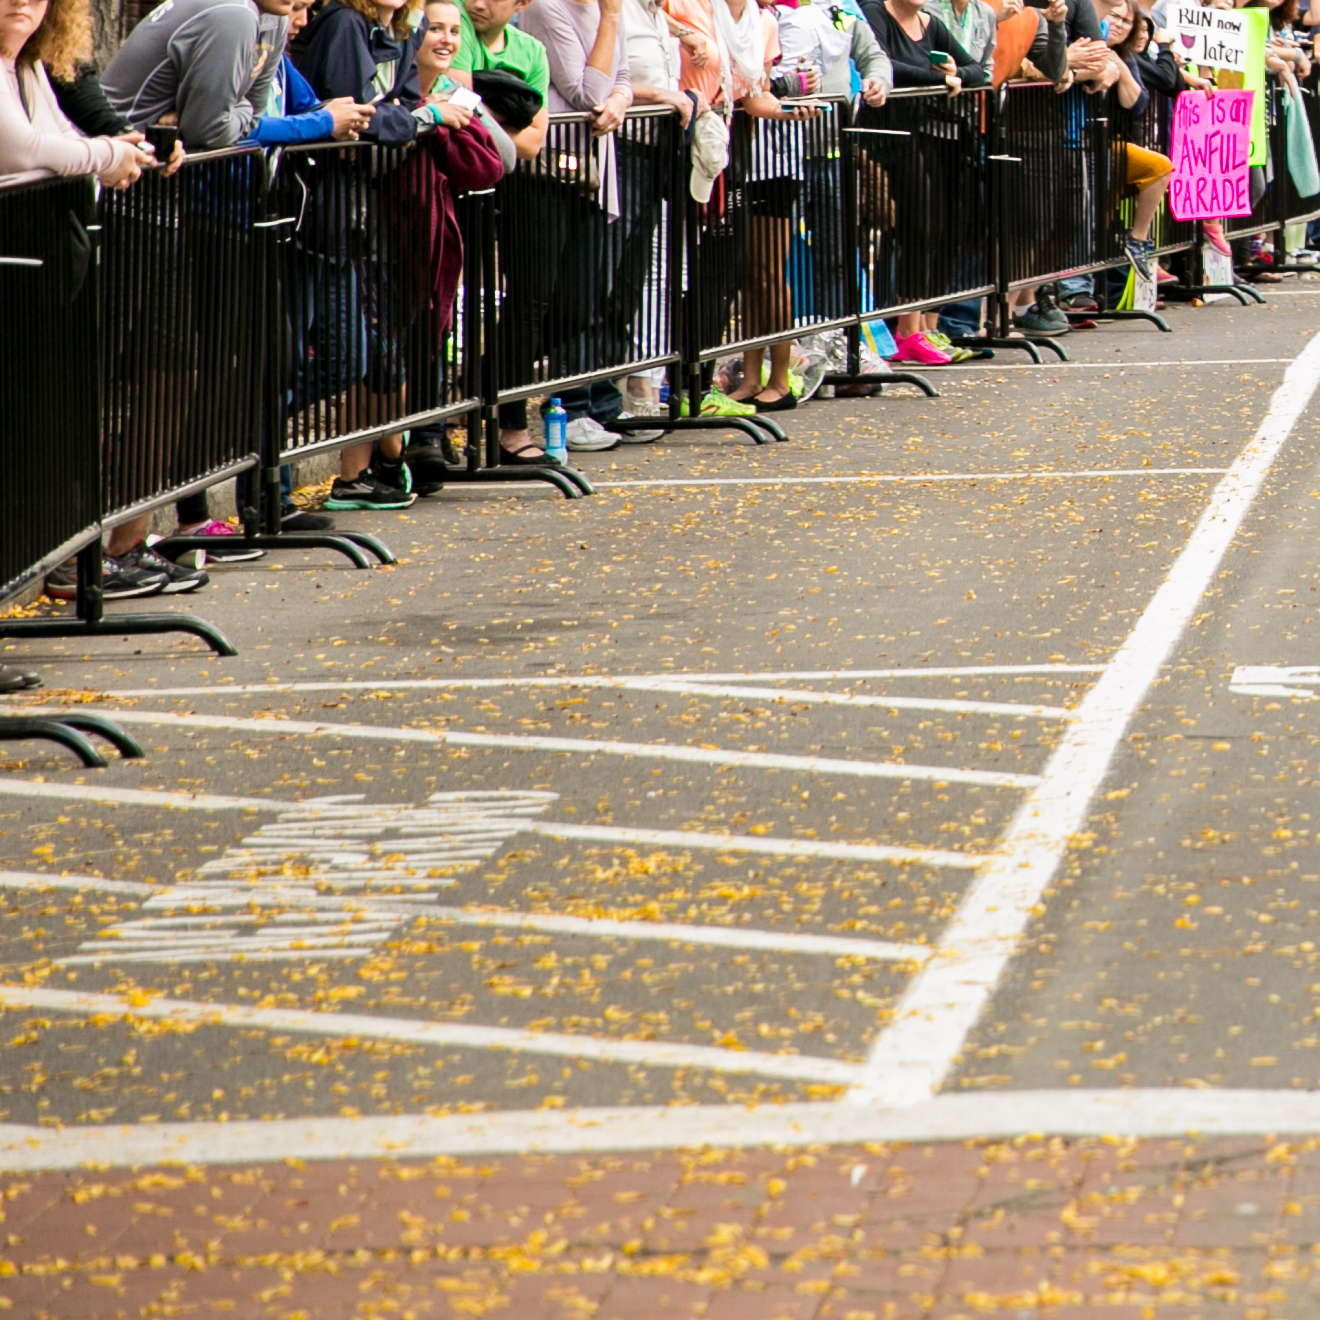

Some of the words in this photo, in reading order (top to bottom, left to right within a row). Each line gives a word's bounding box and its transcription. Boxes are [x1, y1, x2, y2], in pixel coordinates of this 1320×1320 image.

[1179, 8, 1212, 28] RUN
[1217, 18, 1242, 32] now
[1203, 34, 1244, 65] later
[1230, 97, 1248, 126] an
[1180, 129, 1247, 176] AWFUL
[1173, 175, 1247, 214] PARADE
